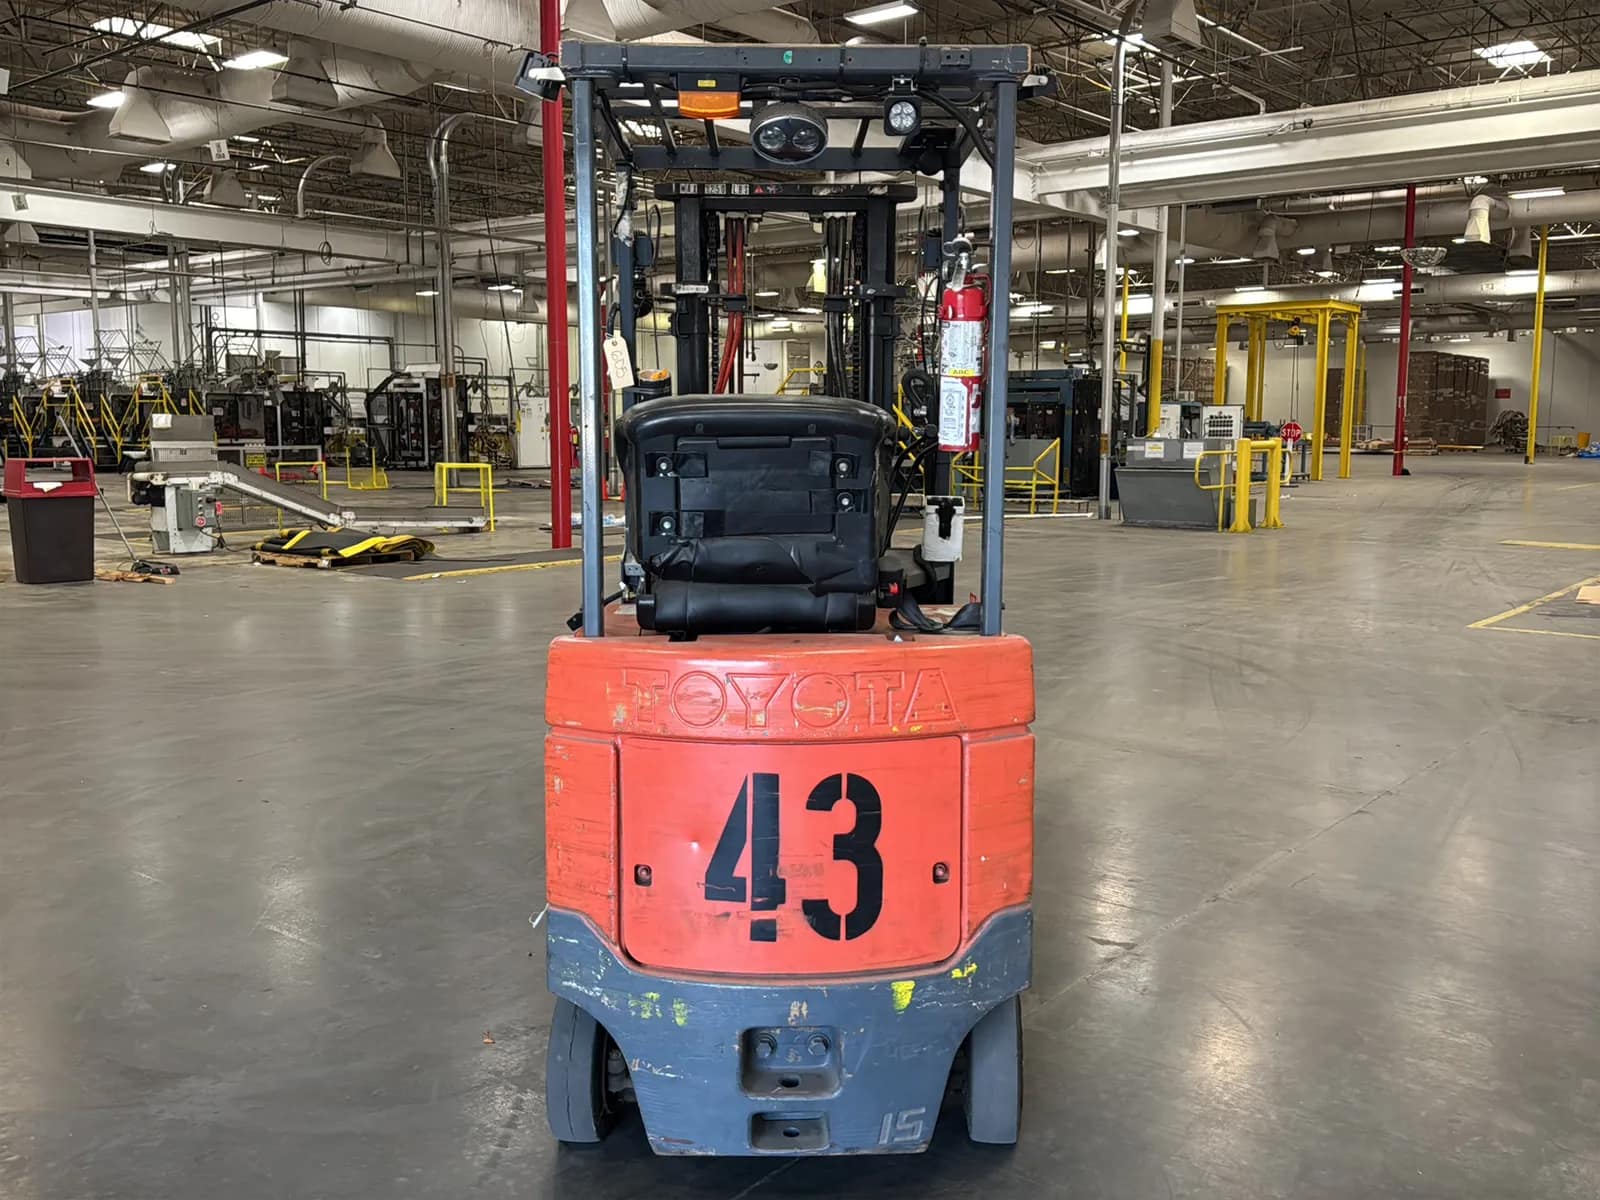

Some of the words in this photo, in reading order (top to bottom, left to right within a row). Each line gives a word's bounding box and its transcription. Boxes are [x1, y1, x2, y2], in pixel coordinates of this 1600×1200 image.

[1281, 429, 1301, 438] STOP
[622, 668, 960, 729] TOYOTA
[704, 772, 883, 942] 43
